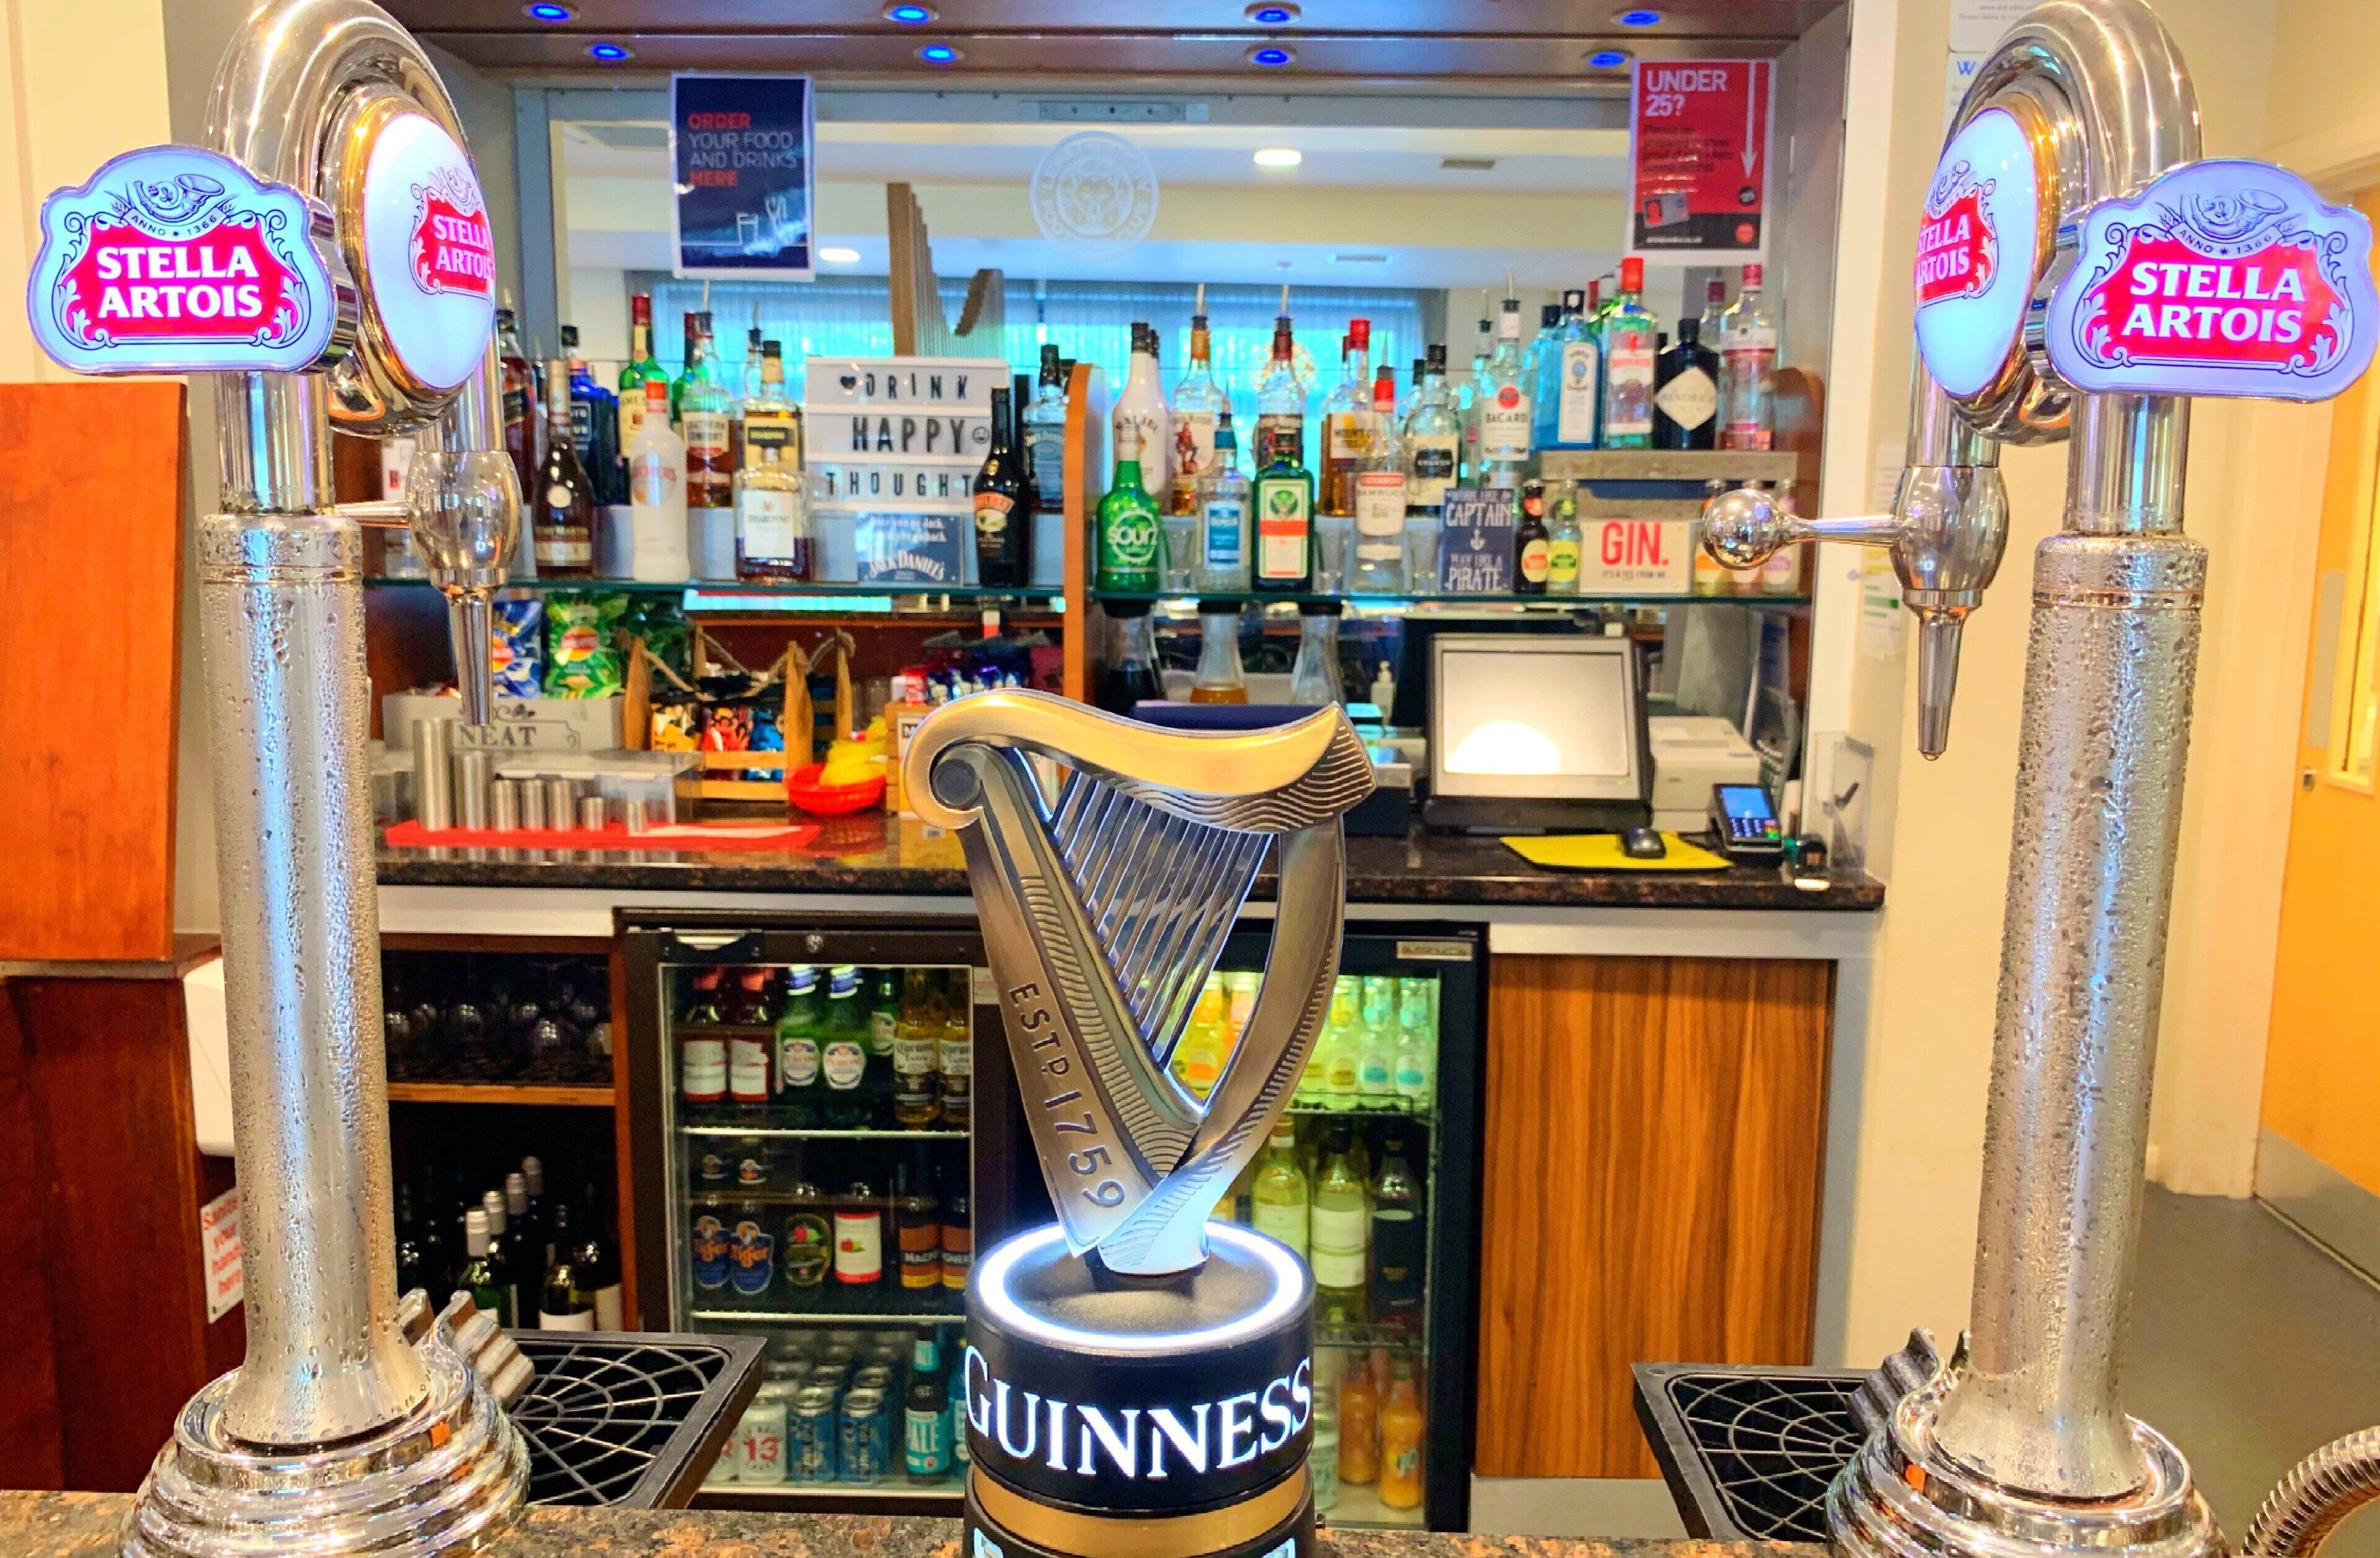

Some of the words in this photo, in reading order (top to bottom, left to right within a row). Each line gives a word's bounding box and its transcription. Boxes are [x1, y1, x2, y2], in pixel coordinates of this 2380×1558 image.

[1646, 69, 1728, 92] UNDER
[1644, 94, 1686, 117] 25?
[687, 112, 751, 130] ORDER
[688, 132, 739, 149] YOUR
[744, 131, 794, 149] FOOD
[690, 152, 728, 169] AND
[732, 152, 797, 169] DRINKS
[689, 169, 738, 187] HERE
[131, 214, 166, 236] ANNO
[187, 214, 217, 235] 1366
[433, 214, 490, 252] STELLA
[2179, 229, 2213, 253] ANNO
[2236, 234, 2272, 254] 1366
[97, 246, 260, 279] STELLA
[436, 245, 491, 280] ARTOIS
[2130, 261, 2306, 302] STELLA
[97, 284, 263, 319] ARTOIS
[2120, 303, 2302, 343] ARTOIS
[865, 372, 968, 400] DRINK
[852, 416, 966, 454] HAPPY
[1446, 503, 1512, 527] CAPTAIN
[1601, 521, 1670, 566] GIN.
[1448, 567, 1503, 591] PIRATE
[458, 724, 537, 746] NEAT
[1044, 1089, 1126, 1208] 1759
[964, 1345, 1312, 1479] GUINNESS
[743, 1436, 780, 1461] 13
